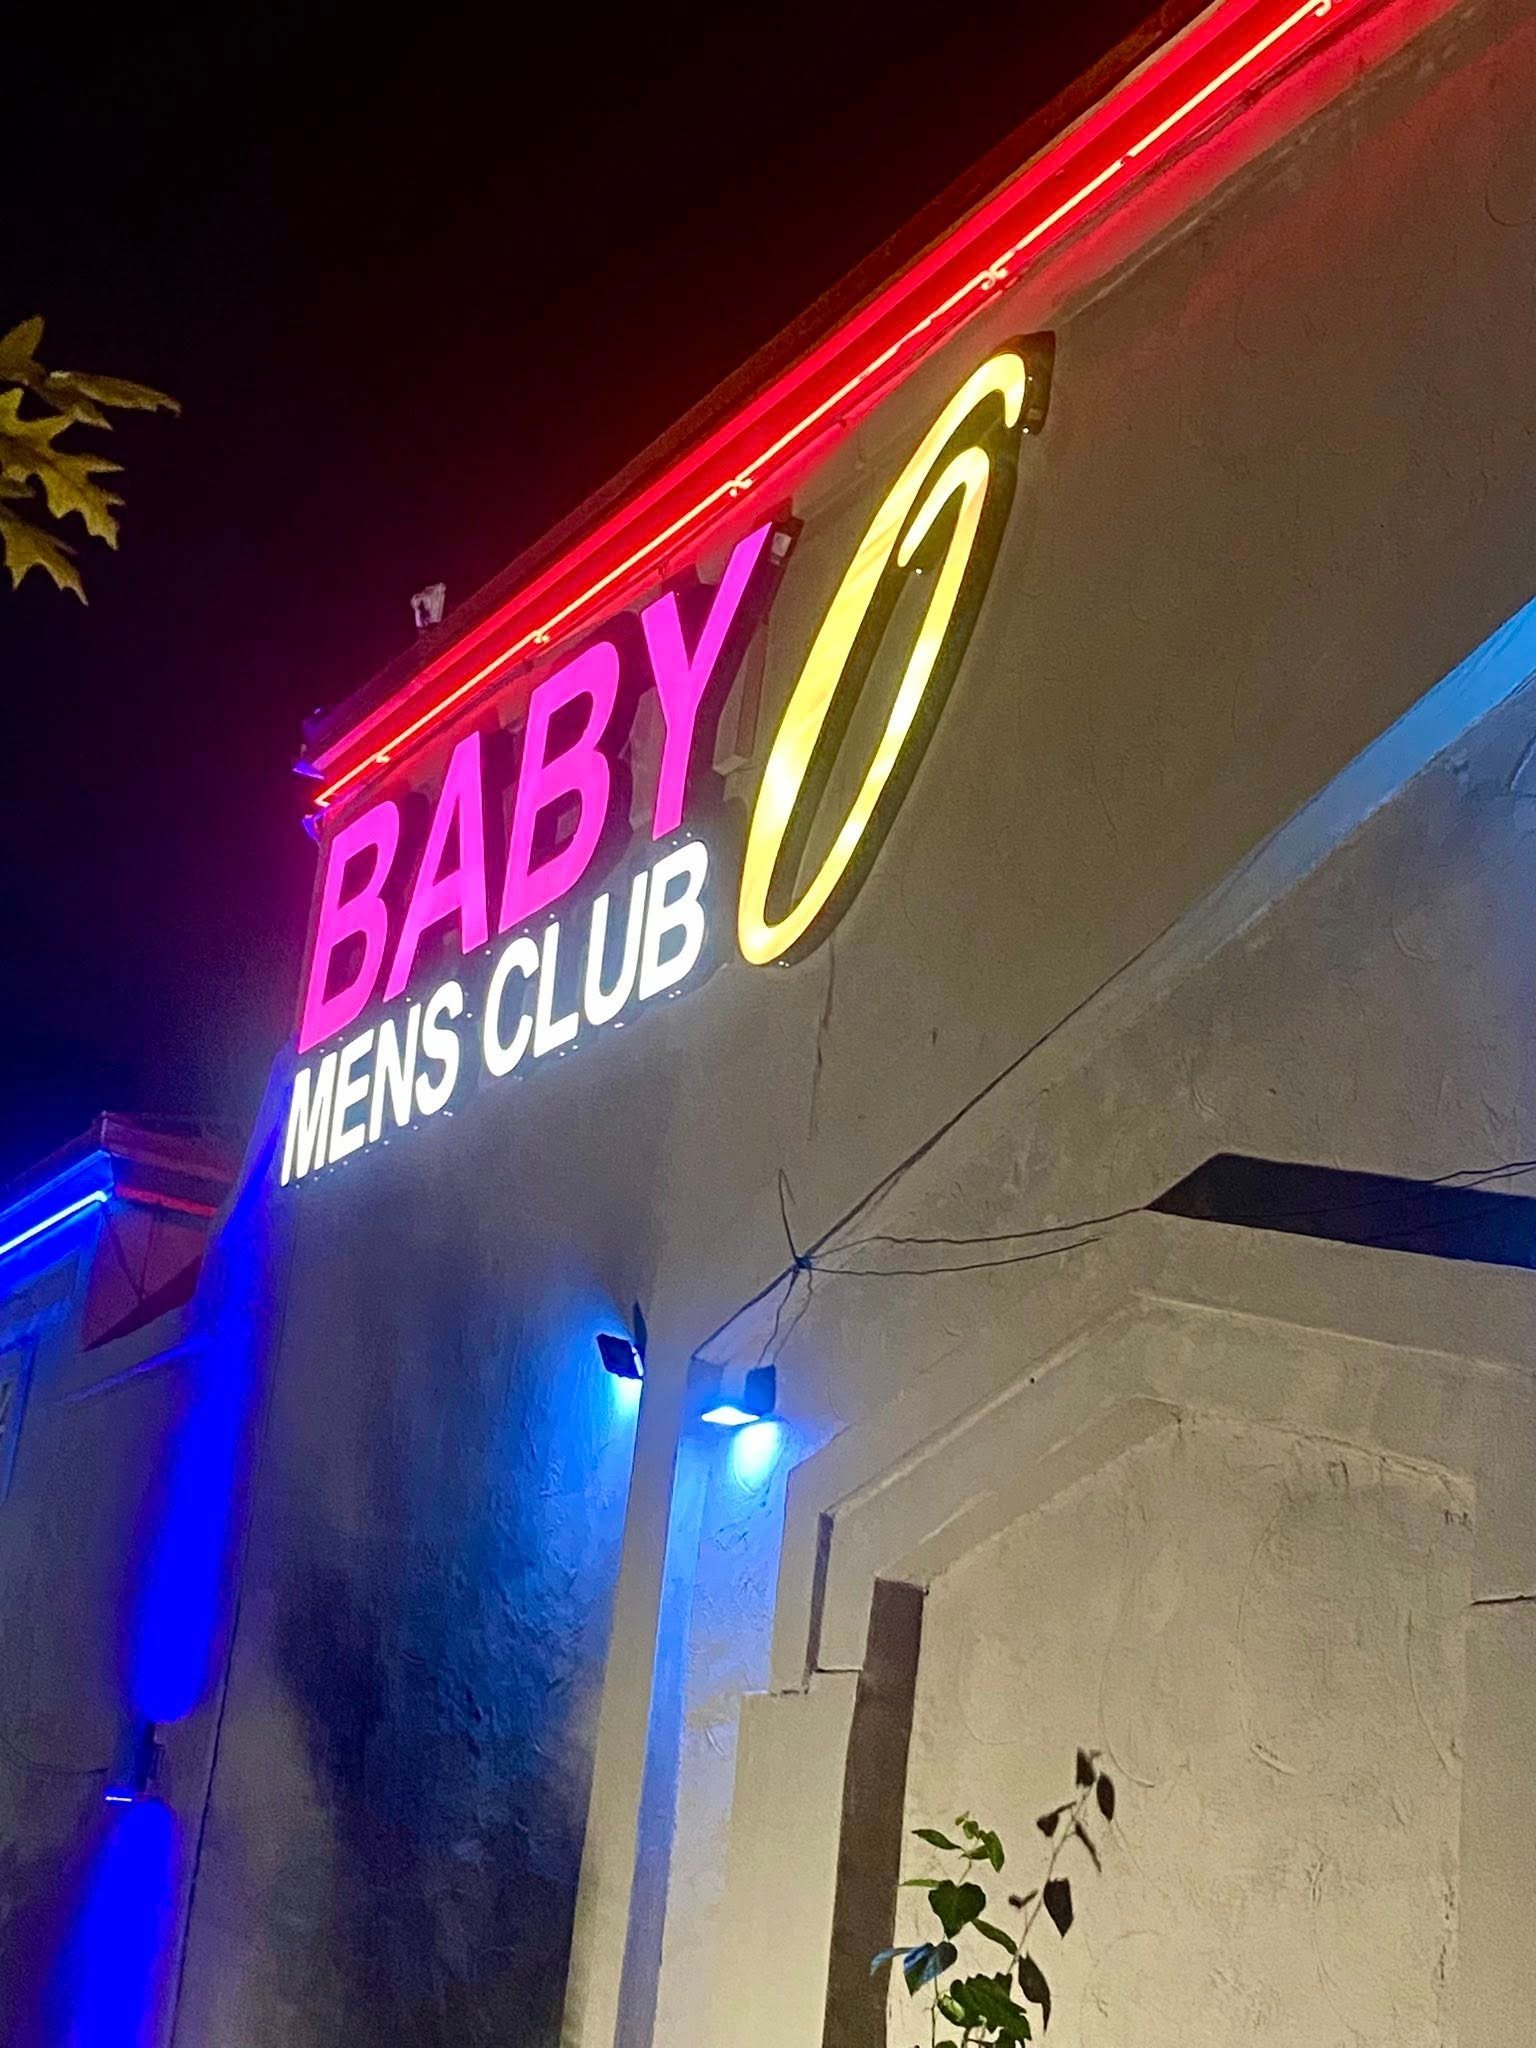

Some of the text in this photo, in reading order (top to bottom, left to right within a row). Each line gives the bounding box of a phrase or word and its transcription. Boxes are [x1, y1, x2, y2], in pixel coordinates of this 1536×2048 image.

[298, 521, 773, 1054] BABY
[280, 840, 709, 1187] MENS CLUB
